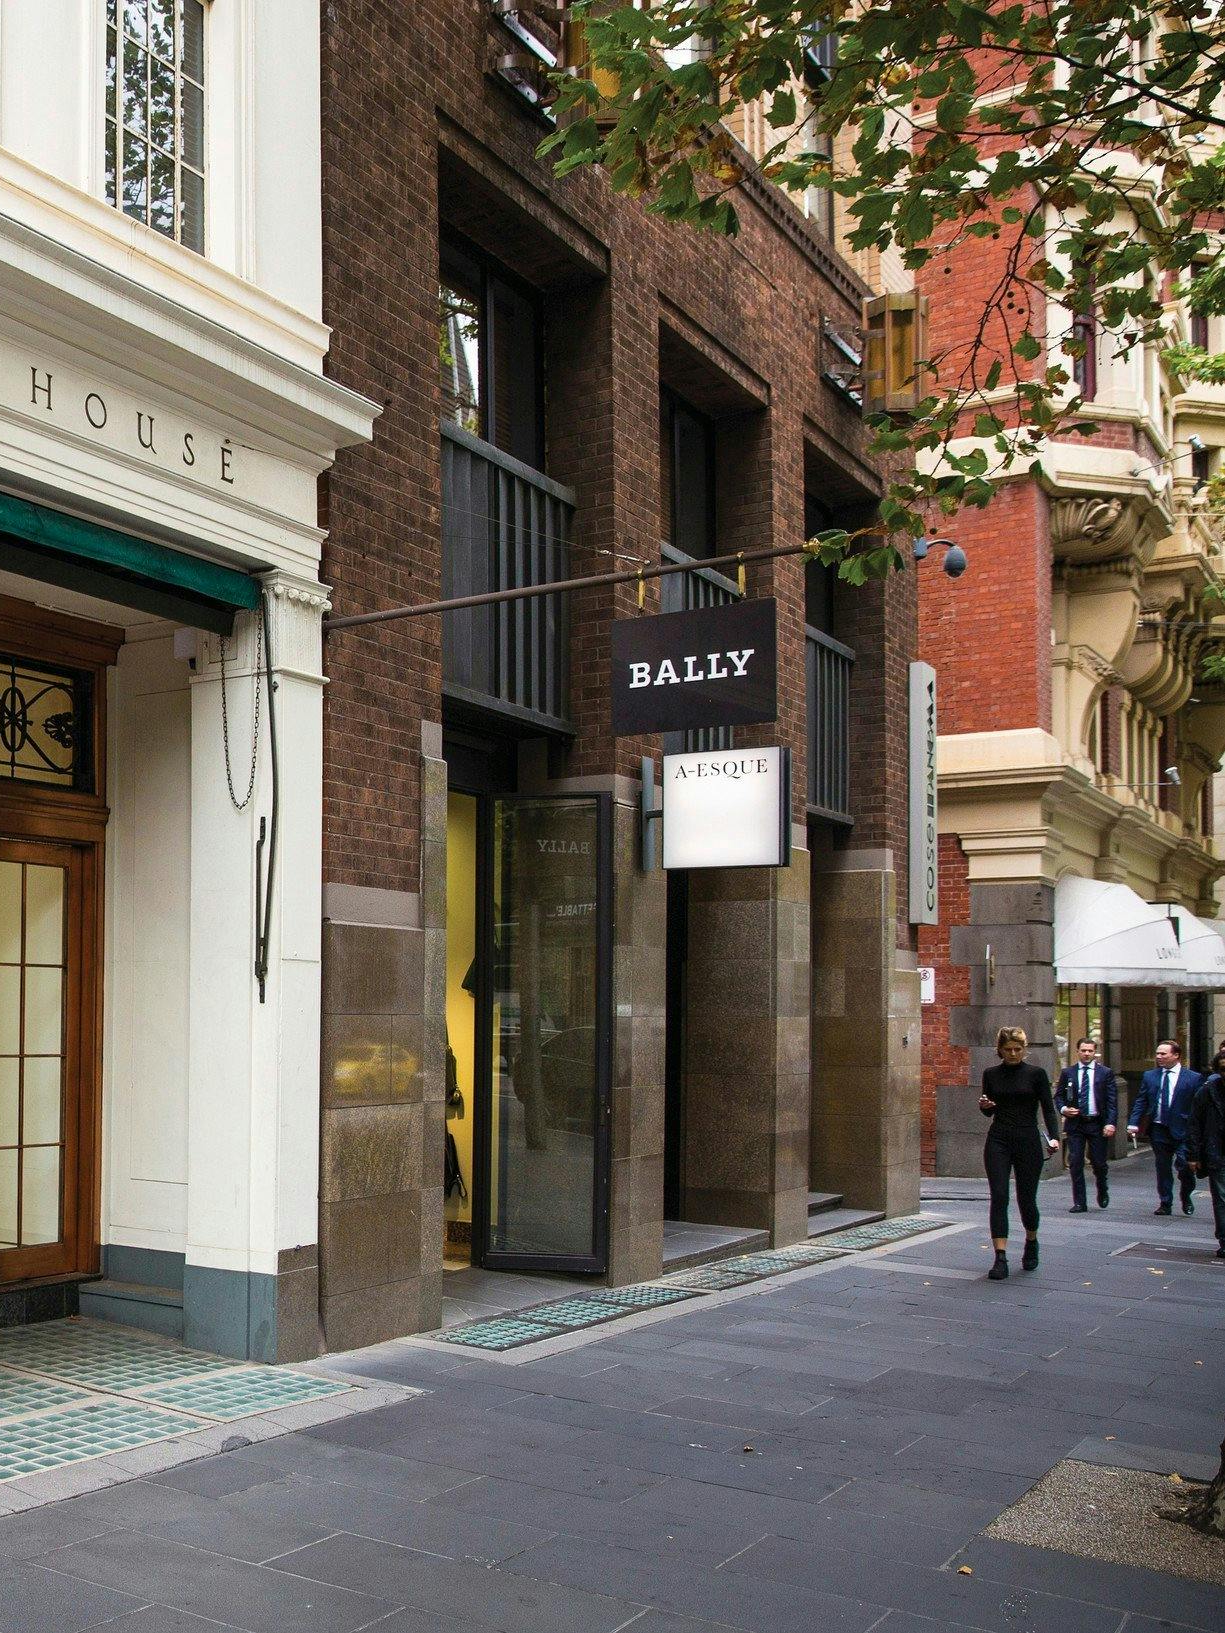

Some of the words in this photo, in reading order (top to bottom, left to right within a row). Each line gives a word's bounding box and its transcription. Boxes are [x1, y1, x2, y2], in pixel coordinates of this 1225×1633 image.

[30, 366, 234, 484] HOUSE
[628, 648, 755, 689] BALLY
[674, 758, 768, 779] A-ESQUE
